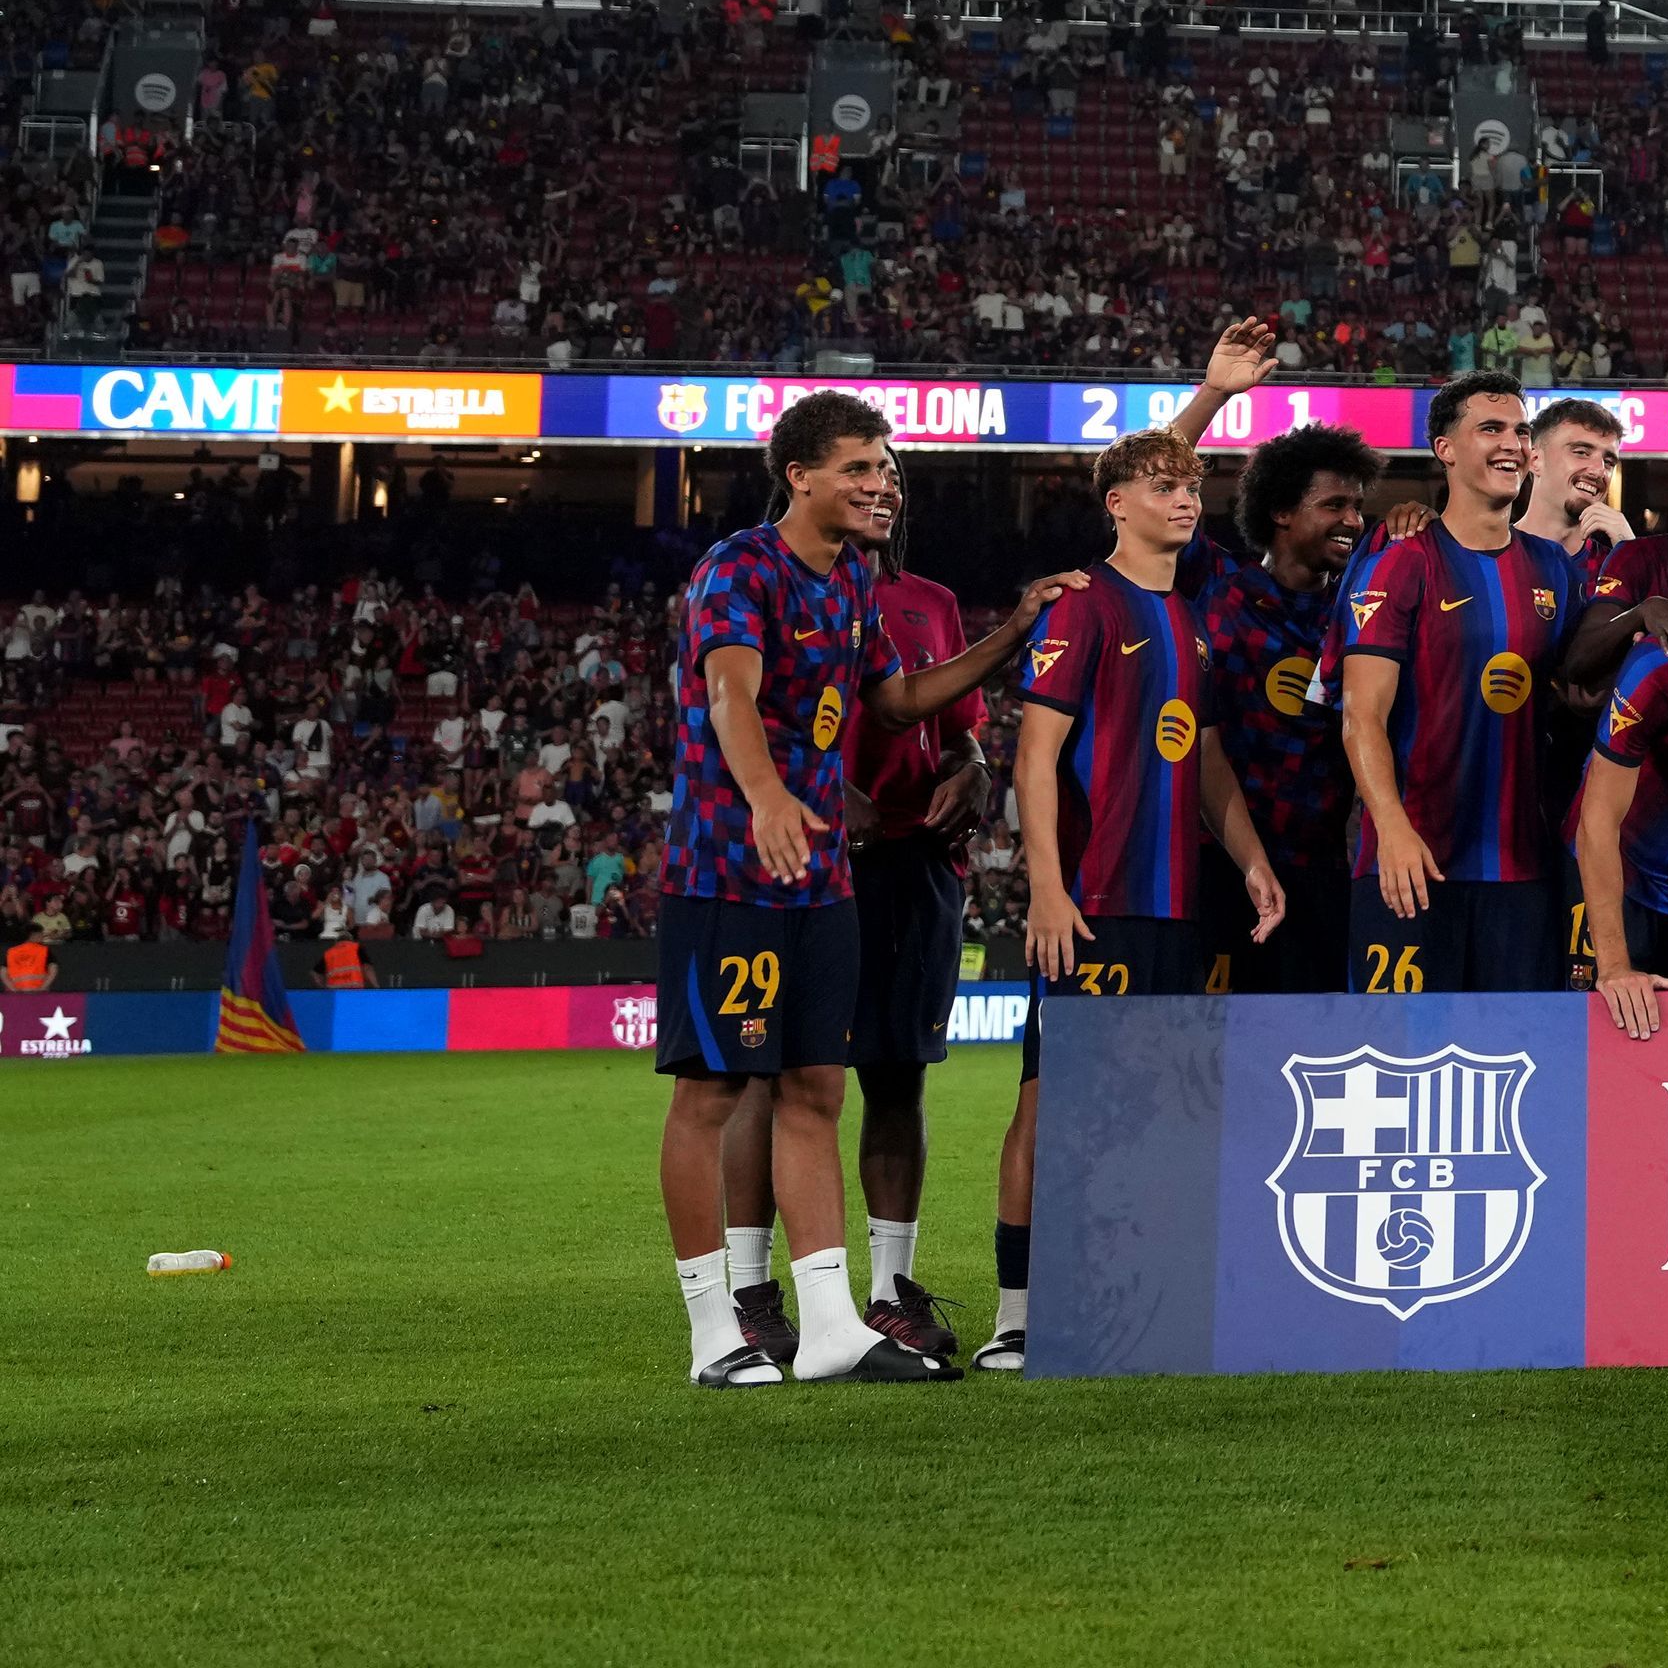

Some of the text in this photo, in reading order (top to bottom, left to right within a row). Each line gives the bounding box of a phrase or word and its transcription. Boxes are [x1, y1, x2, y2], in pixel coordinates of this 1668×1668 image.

[362, 388, 505, 416] ESTRELLA
[725, 384, 774, 432] FC
[783, 385, 1006, 436] ELONA
[1082, 389, 1118, 439] 2
[1288, 391, 1310, 429] 1
[718, 951, 780, 1015] 29
[1367, 944, 1423, 993] 26
[945, 996, 1030, 1041] AMP
[21, 1039, 91, 1054] ESTRELLA
[1359, 1157, 1457, 1191] FCB
